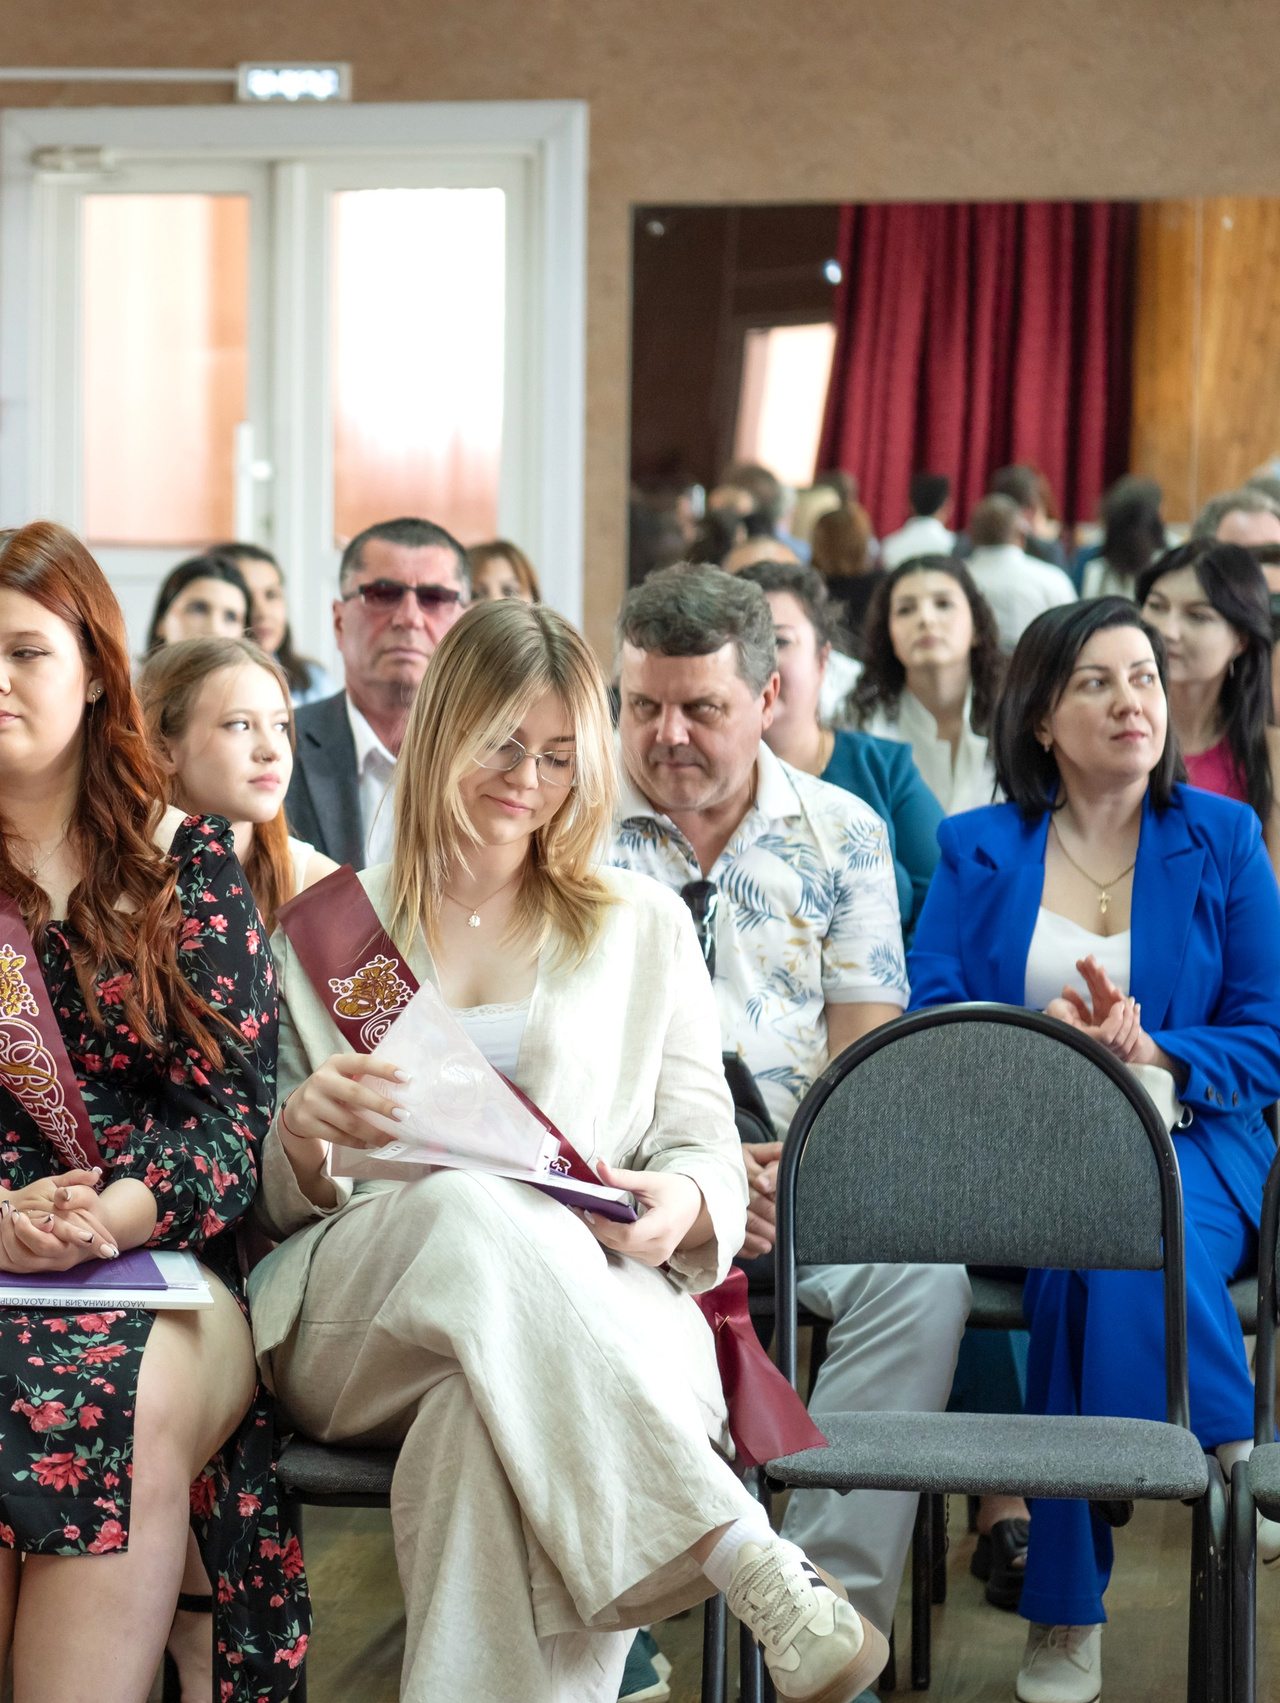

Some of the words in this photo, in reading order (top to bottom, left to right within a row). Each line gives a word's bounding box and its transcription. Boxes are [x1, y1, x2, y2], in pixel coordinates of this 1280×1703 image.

[52, 1298, 62, 1307] 13
[65, 1298, 115, 1308] ГИМНАЗИЯ
[116, 1300, 146, 1308] МАОУ
